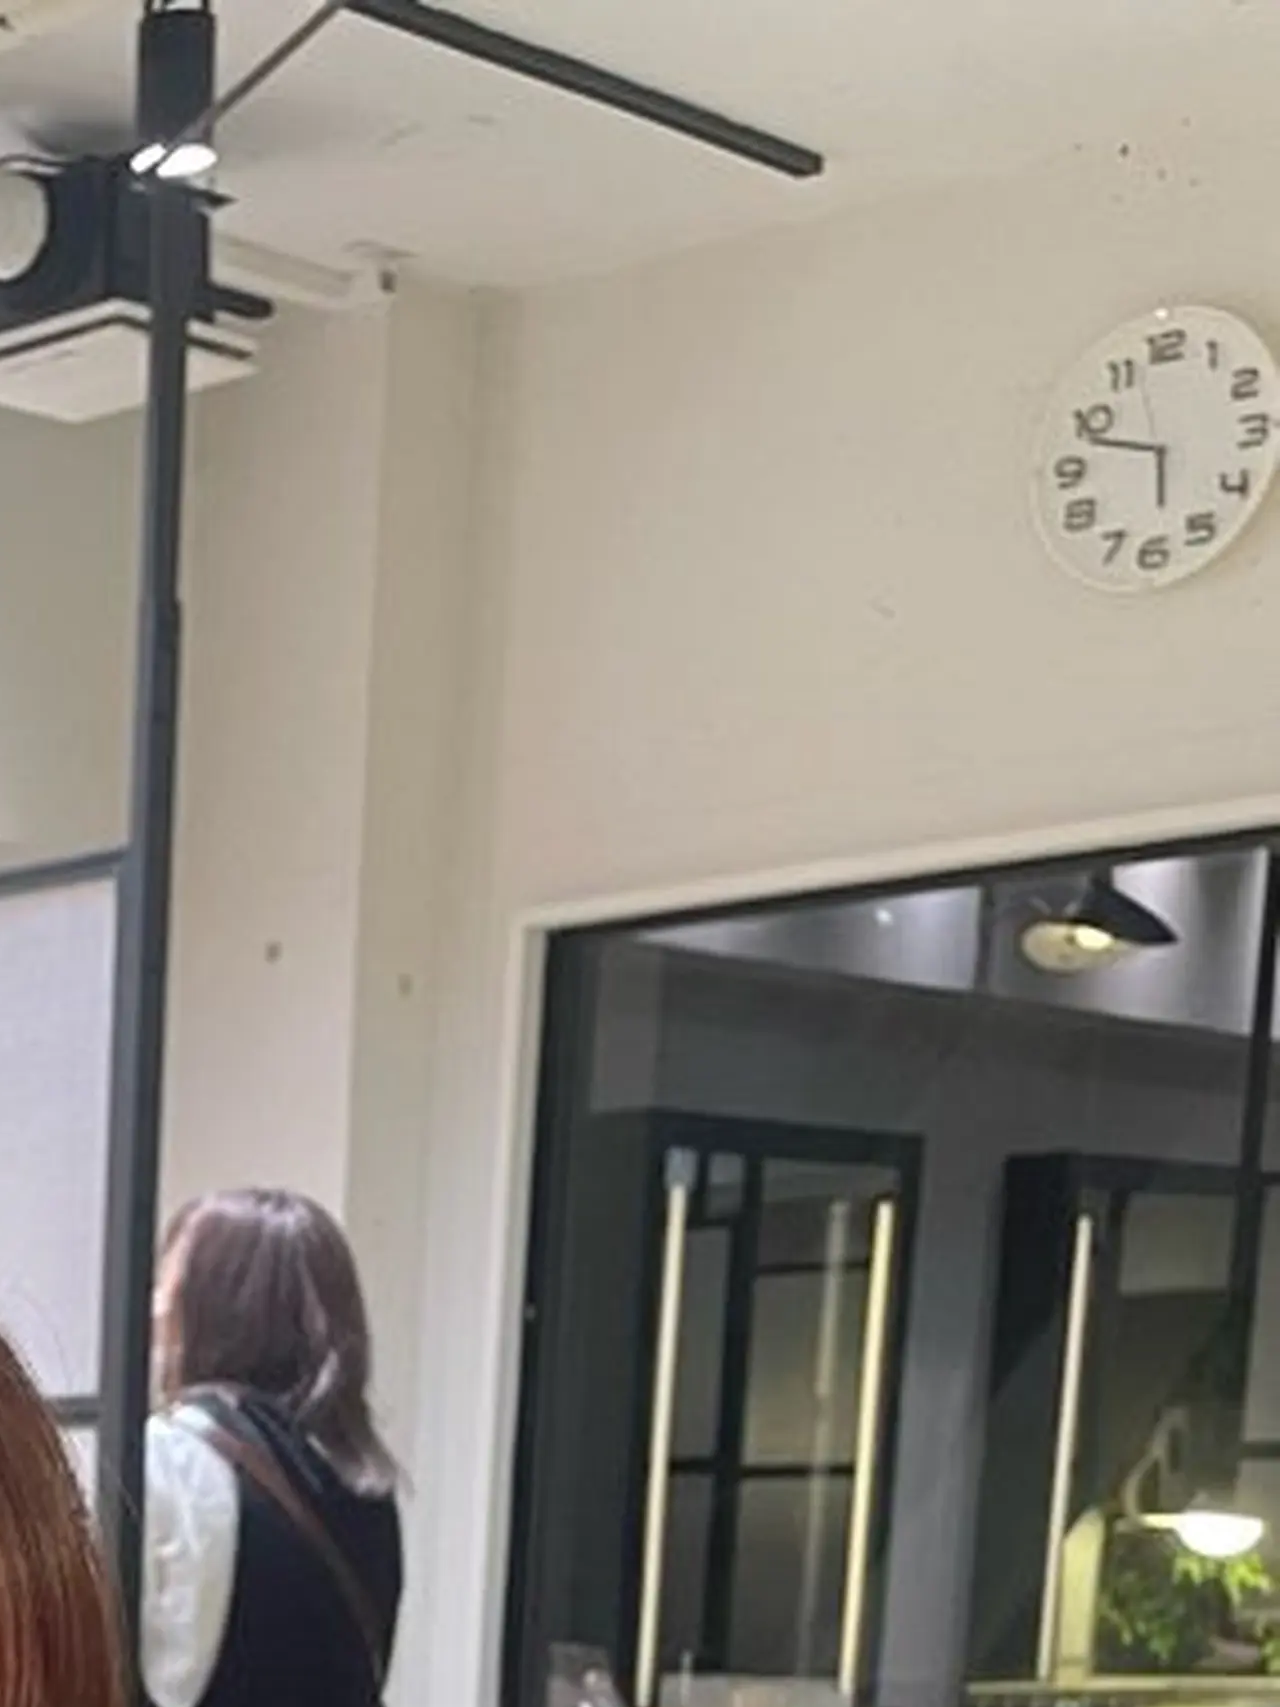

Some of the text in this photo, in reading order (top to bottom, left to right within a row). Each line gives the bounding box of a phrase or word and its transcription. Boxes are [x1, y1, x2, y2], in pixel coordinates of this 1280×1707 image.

[1145, 328, 1187, 365] 12
[1205, 339, 1219, 372] 1
[1107, 357, 1135, 393] 11
[1229, 366, 1260, 401] 2
[1072, 403, 1115, 439] 10
[1236, 412, 1270, 450] 3
[1053, 455, 1087, 490] 9
[1218, 467, 1250, 497] 4
[1061, 497, 1097, 533] 8
[1183, 511, 1217, 547] 5
[1101, 529, 1128, 567] 7
[1135, 534, 1171, 571] 6
